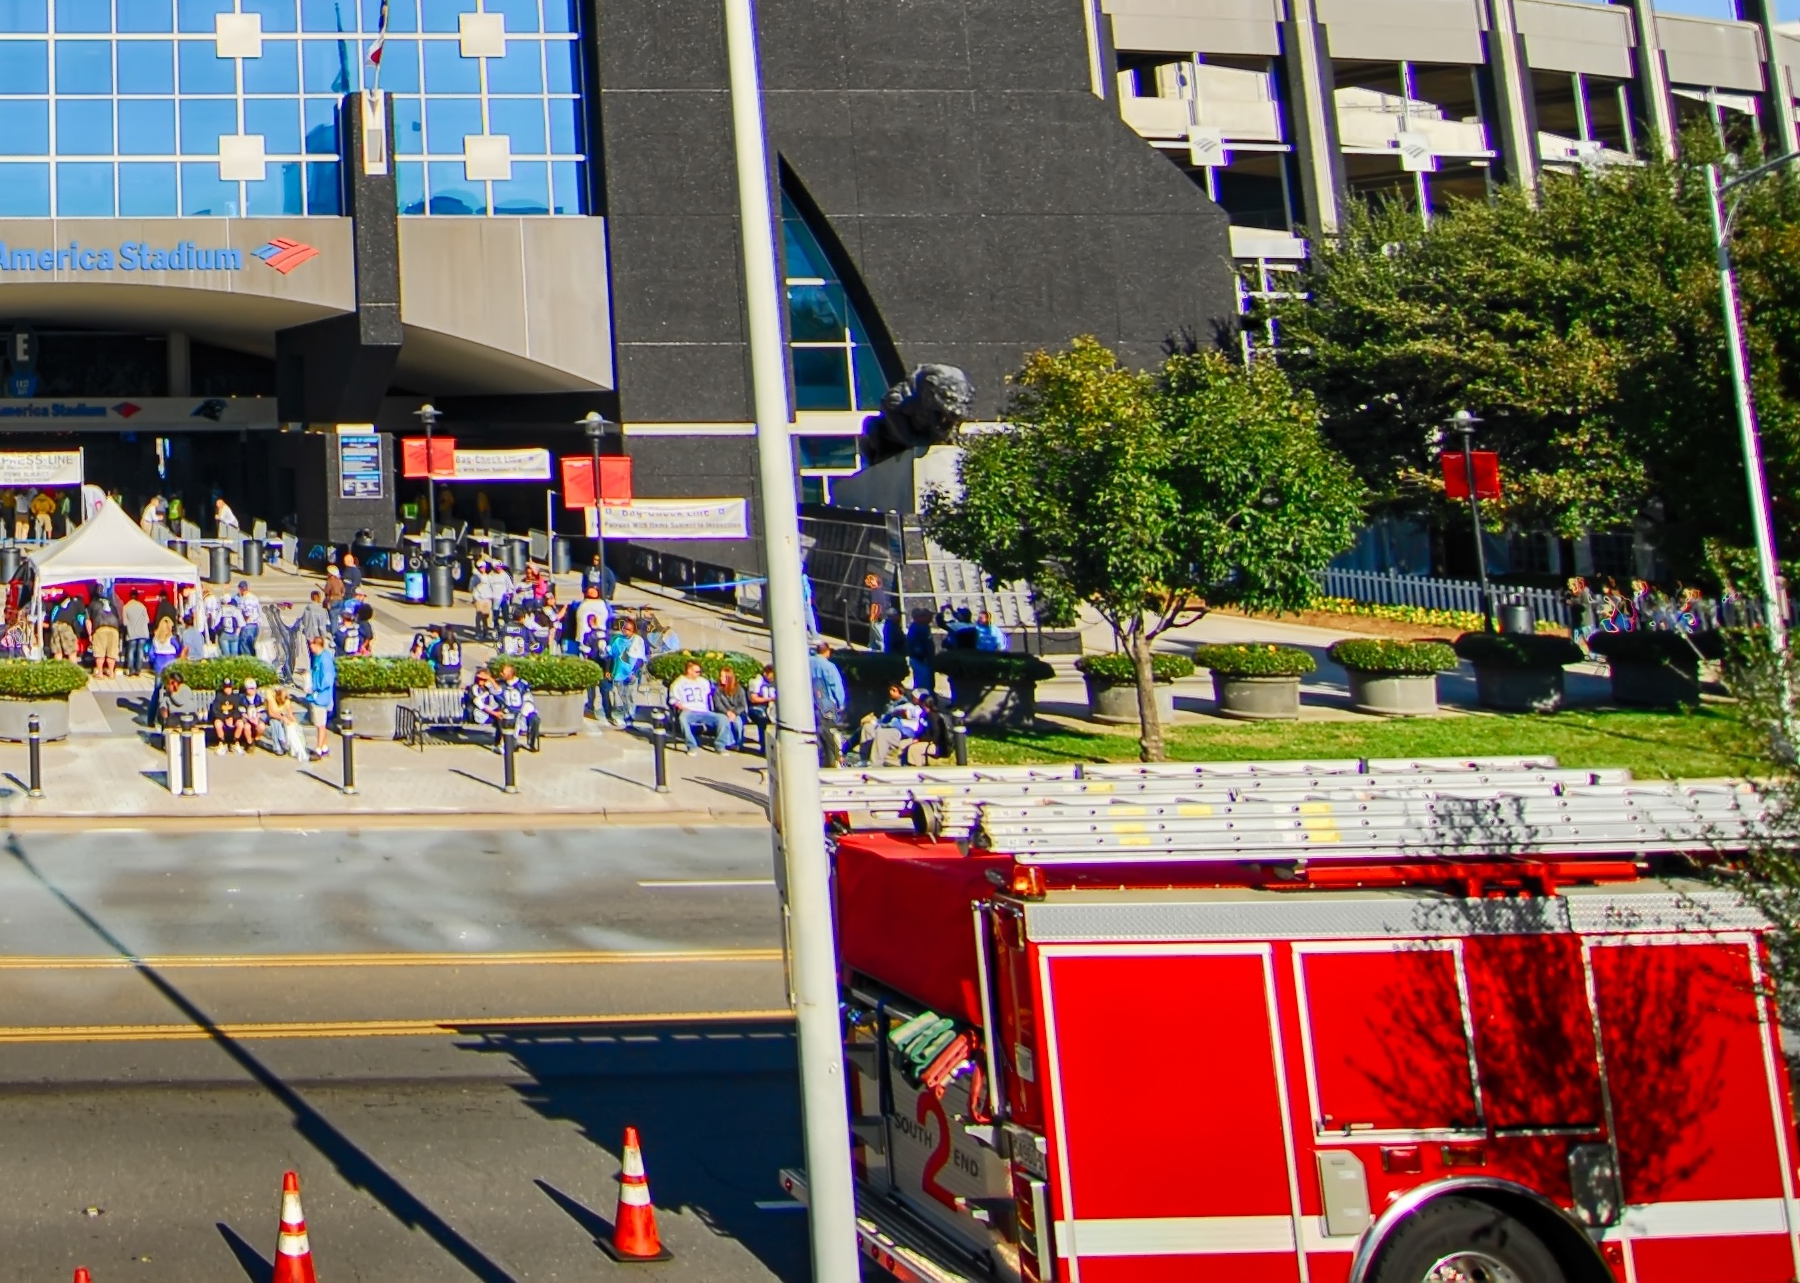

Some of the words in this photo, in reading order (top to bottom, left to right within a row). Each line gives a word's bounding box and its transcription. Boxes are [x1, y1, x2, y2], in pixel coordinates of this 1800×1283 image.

[118, 241, 242, 271] Stadium
[16, 333, 29, 361] E
[51, 403, 107, 417] Stadium
[48, 454, 74, 465] LINE
[894, 1112, 933, 1149] SOUTH
[953, 1147, 980, 1178] END
[916, 1090, 960, 1213] 2
